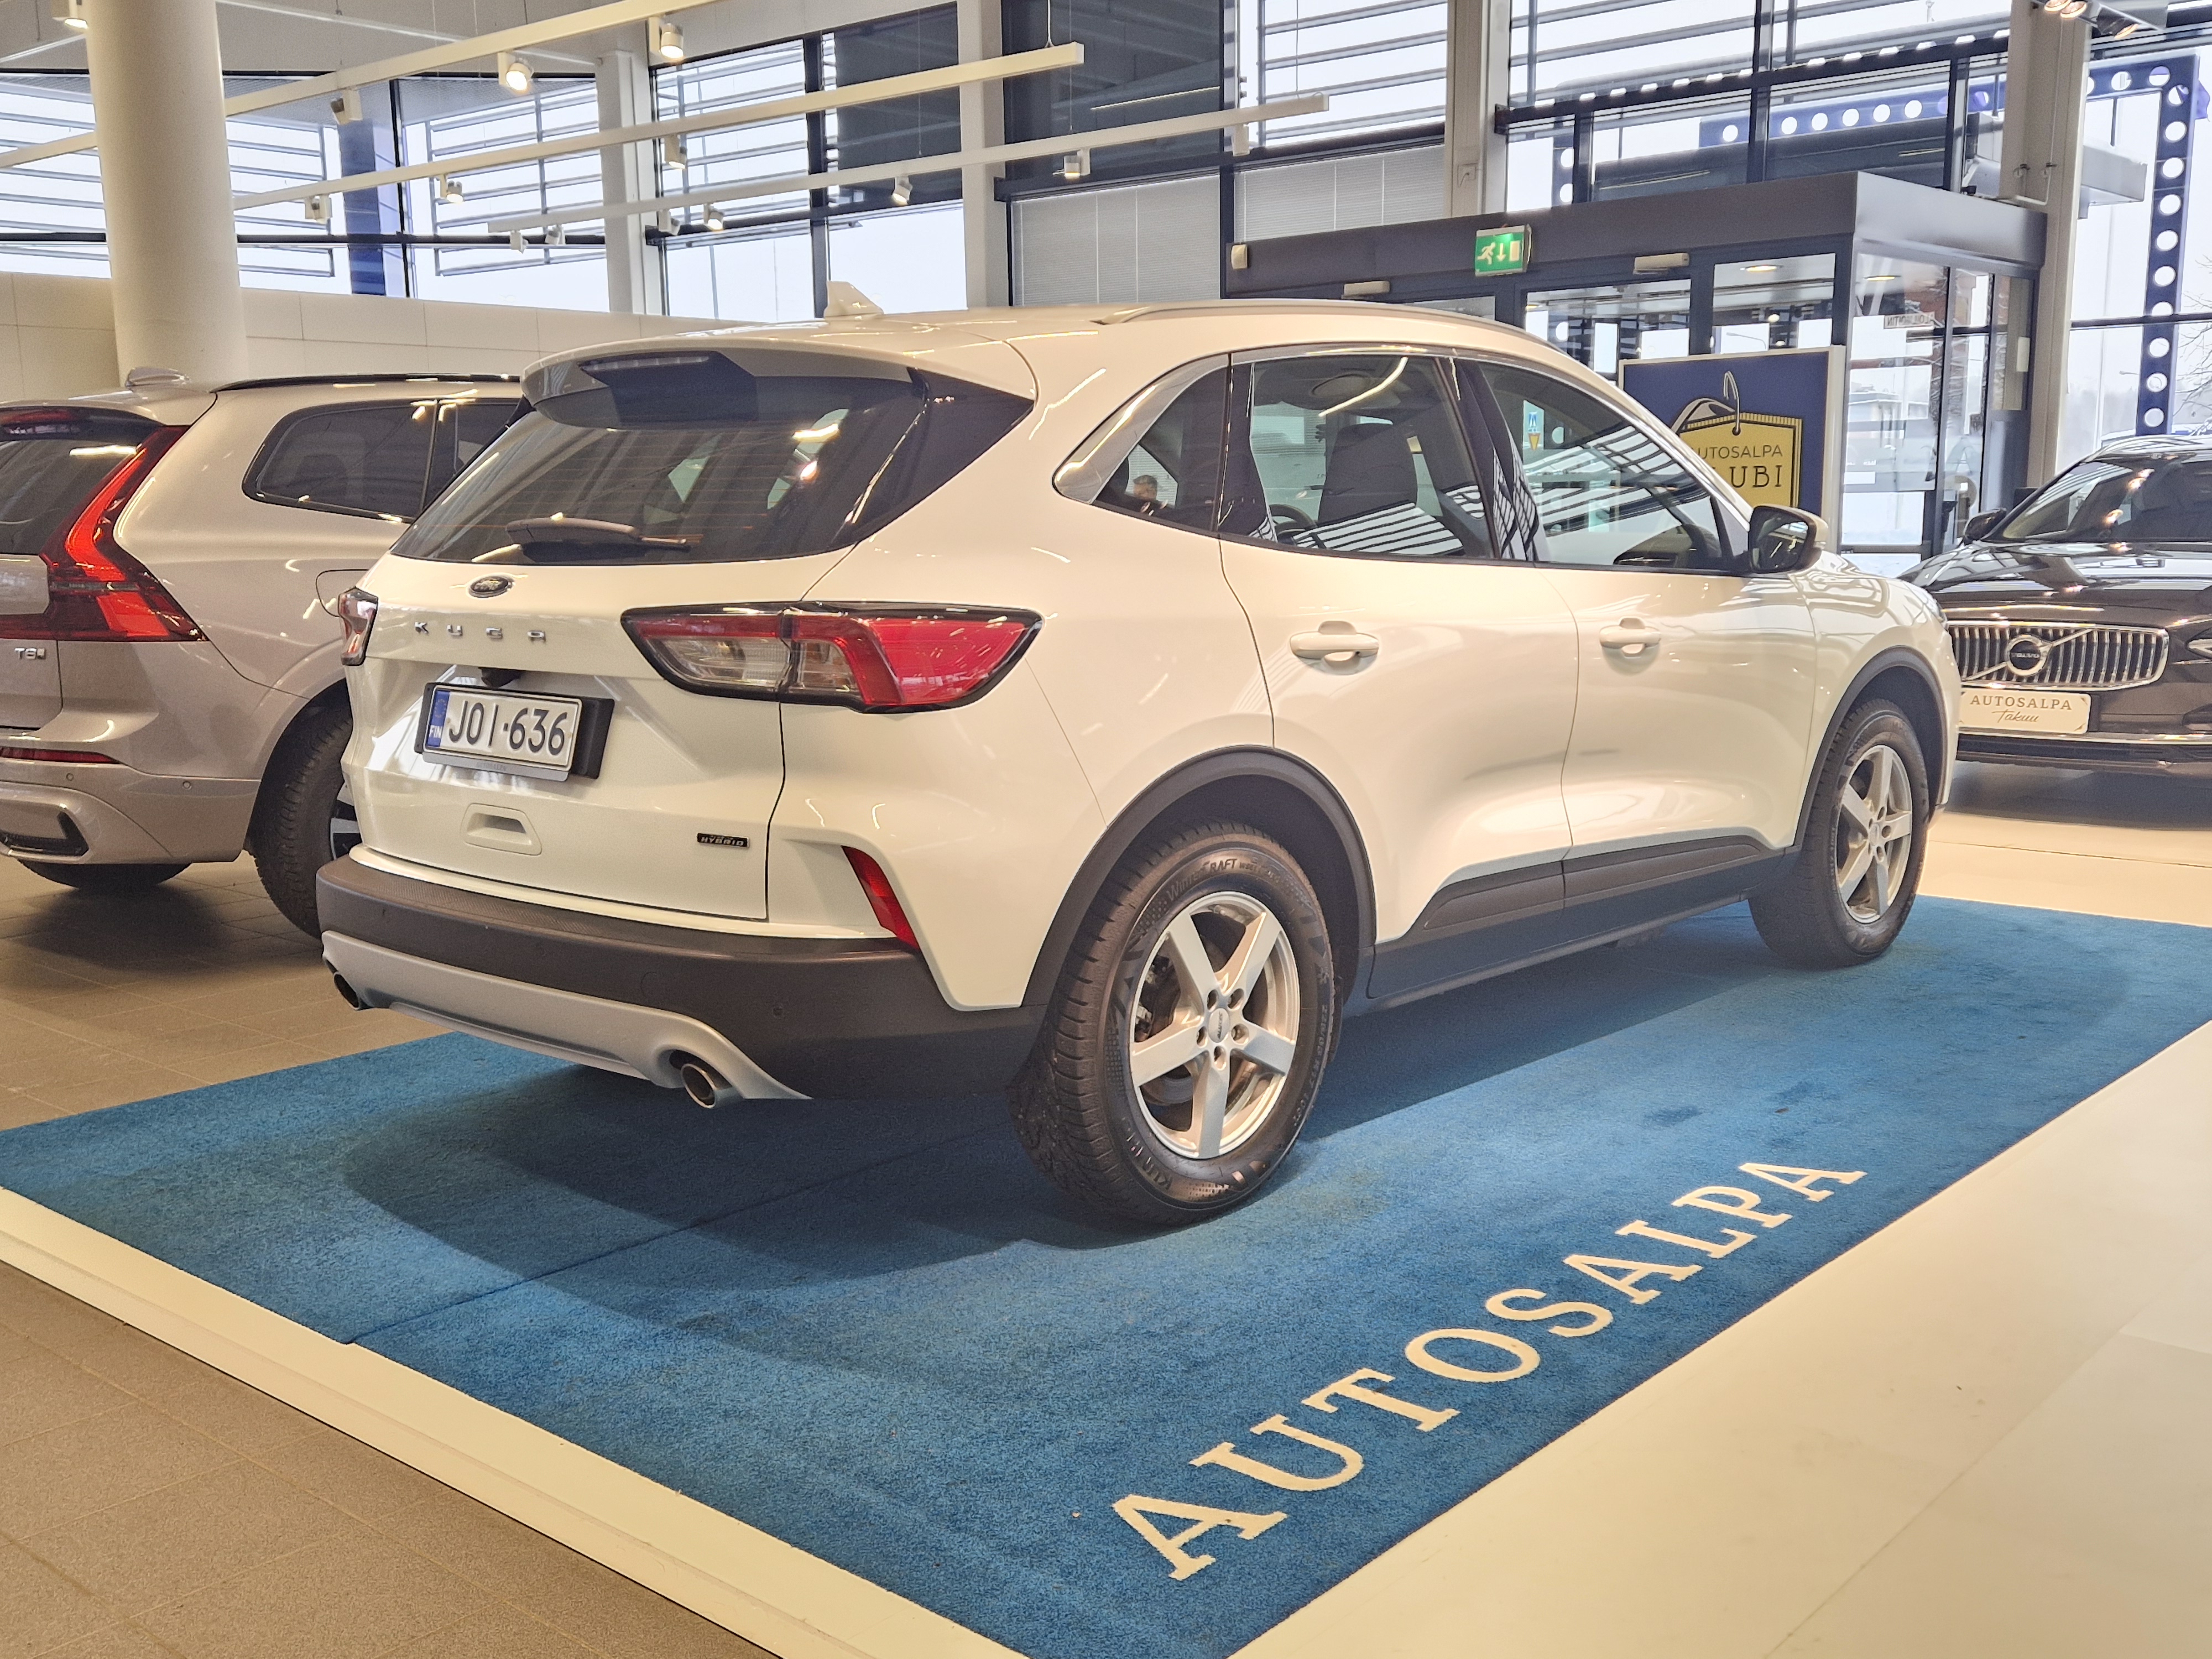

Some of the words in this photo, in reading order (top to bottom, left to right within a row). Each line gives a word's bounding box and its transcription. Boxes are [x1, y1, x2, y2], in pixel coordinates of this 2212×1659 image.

[1692, 445, 1783, 460] UTOSALPA
[415, 621, 546, 644] KUGA
[1969, 695, 2073, 711] AUTOSALPA
[1991, 708, 2039, 723] Takuu
[429, 724, 442, 739] FIN
[448, 700, 567, 756] JOI-636
[701, 837, 744, 846] HYBRID
[1112, 1161, 1867, 1581] AUTOSALPA
